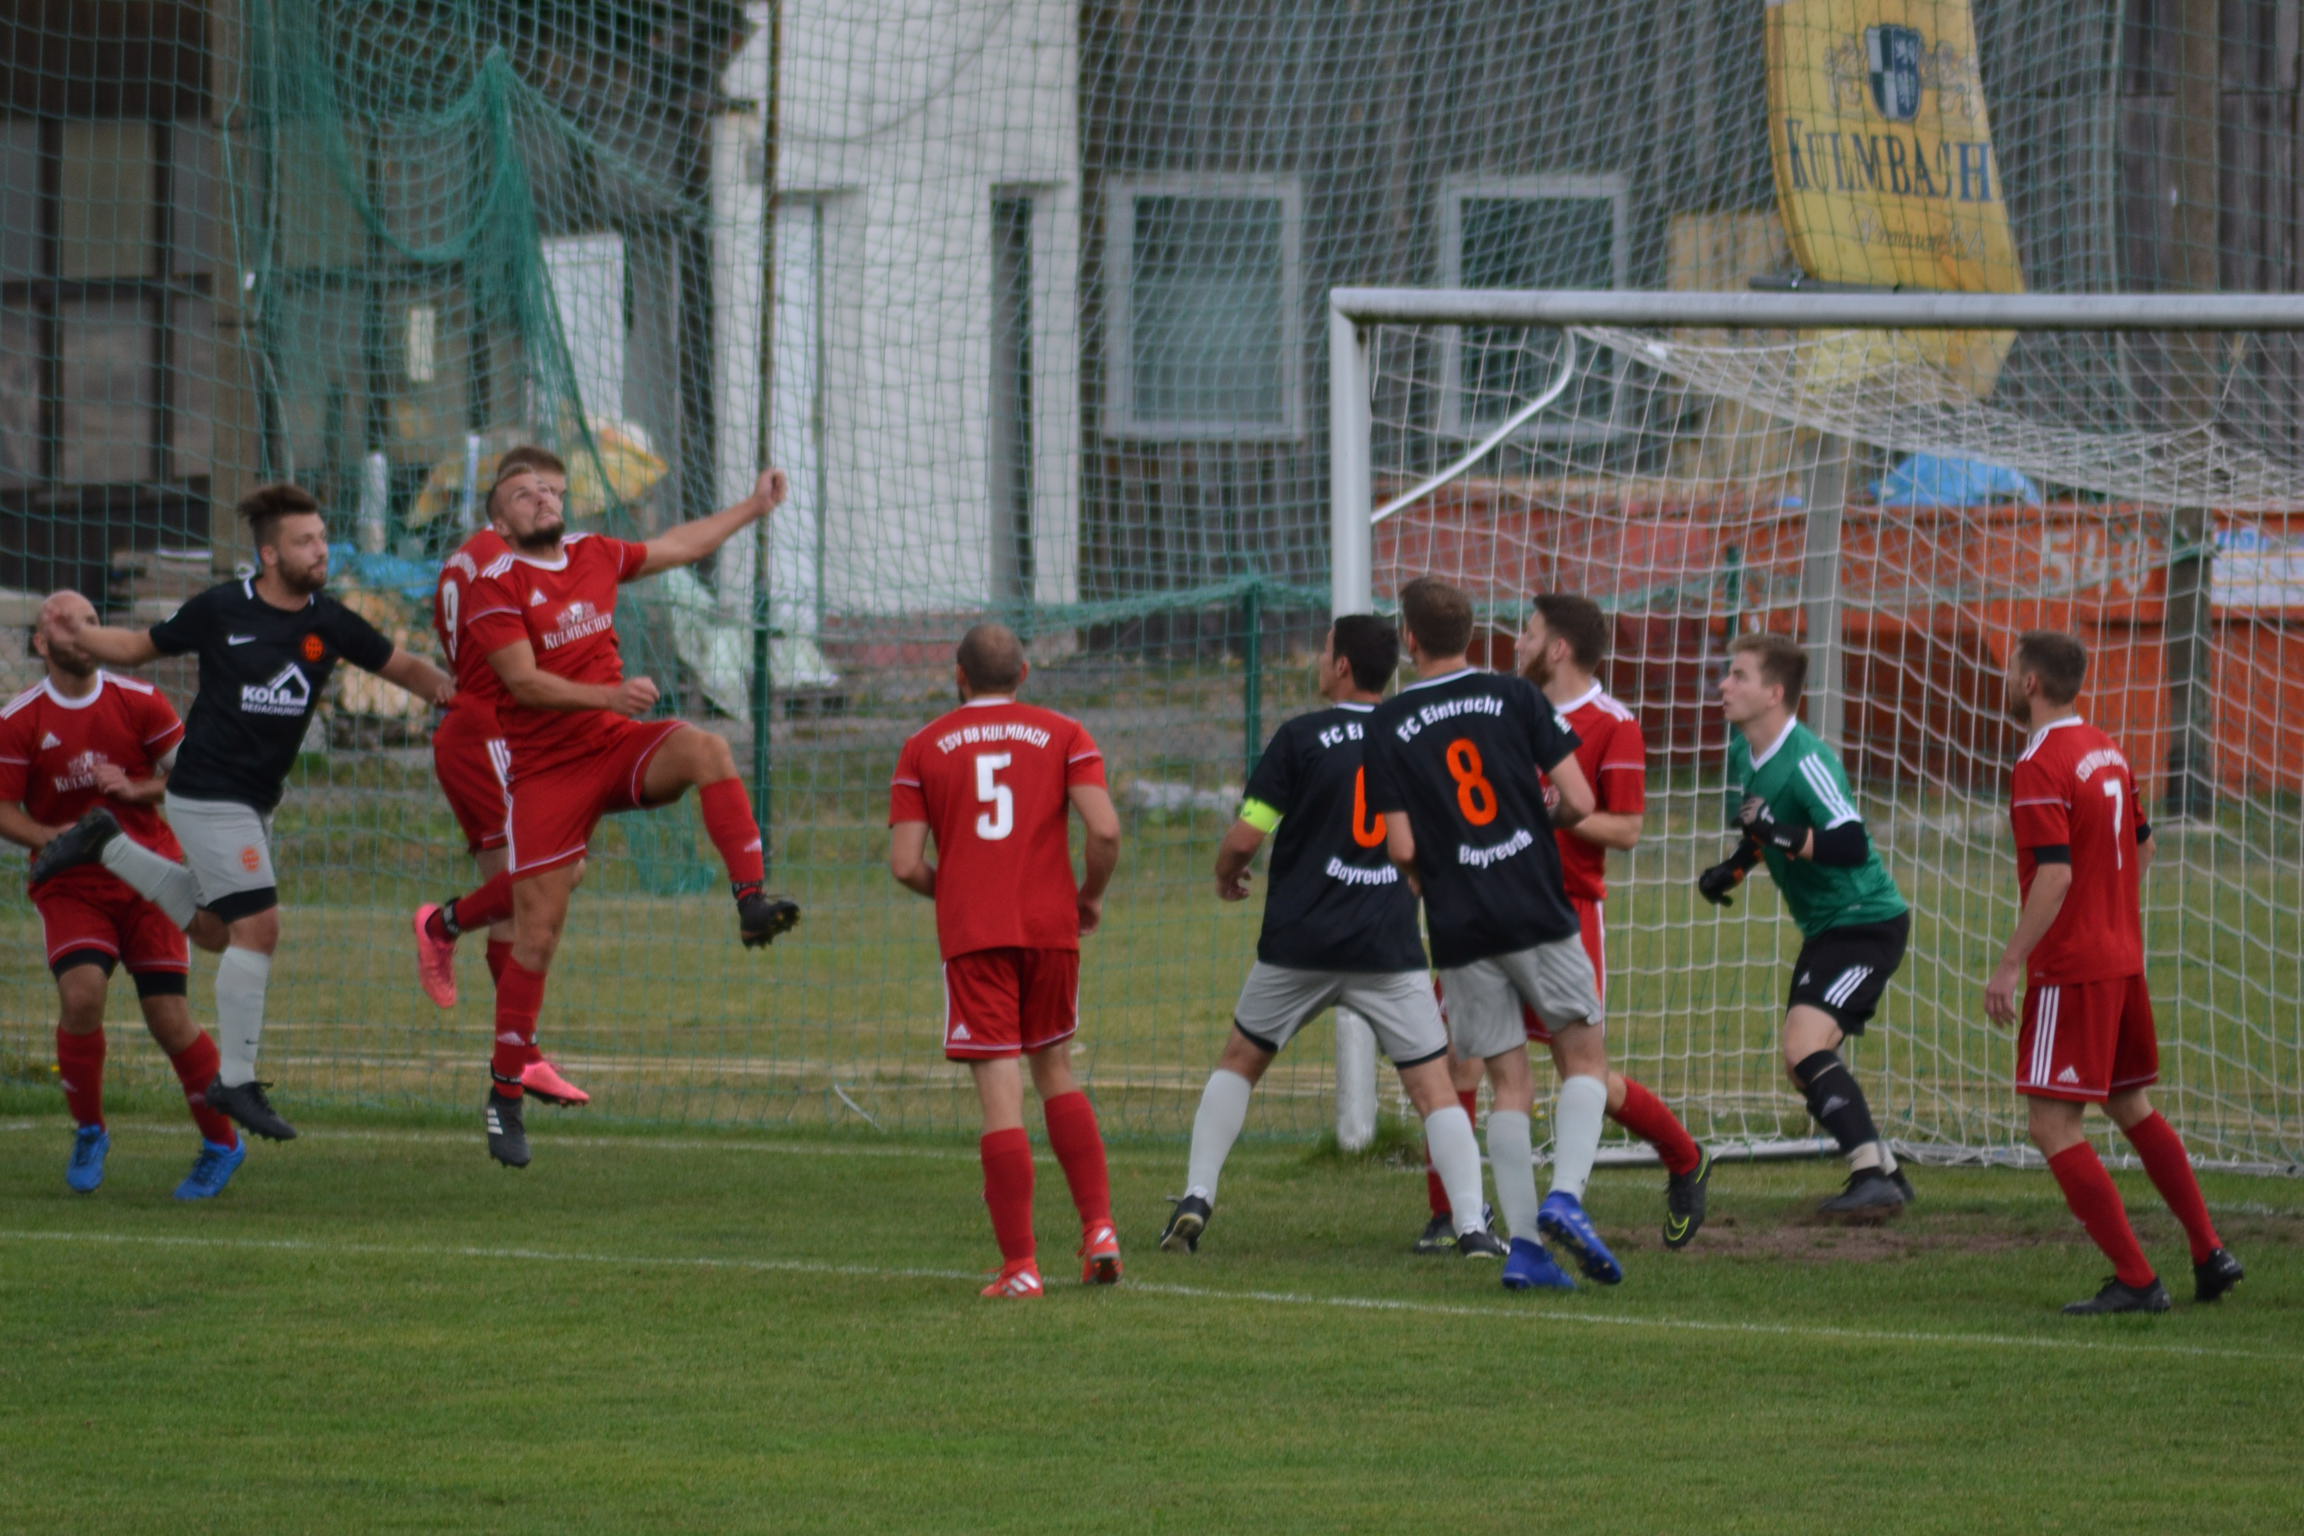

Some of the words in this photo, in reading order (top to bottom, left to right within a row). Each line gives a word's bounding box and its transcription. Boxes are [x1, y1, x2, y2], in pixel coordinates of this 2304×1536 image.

[543, 612, 612, 650] KULMBACHER
[242, 684, 291, 705] KOLB
[982, 724, 1051, 749] KULMBACH
[1318, 727, 1344, 749] FC
[1396, 716, 1422, 743] FC
[1419, 695, 1504, 726] Eintracht
[975, 751, 1014, 841] 5
[1446, 737, 1499, 827] 8
[2103, 777, 2123, 871] 7
[1458, 828, 1534, 870] Bayreuth
[1325, 855, 1399, 887] Bayreuth
